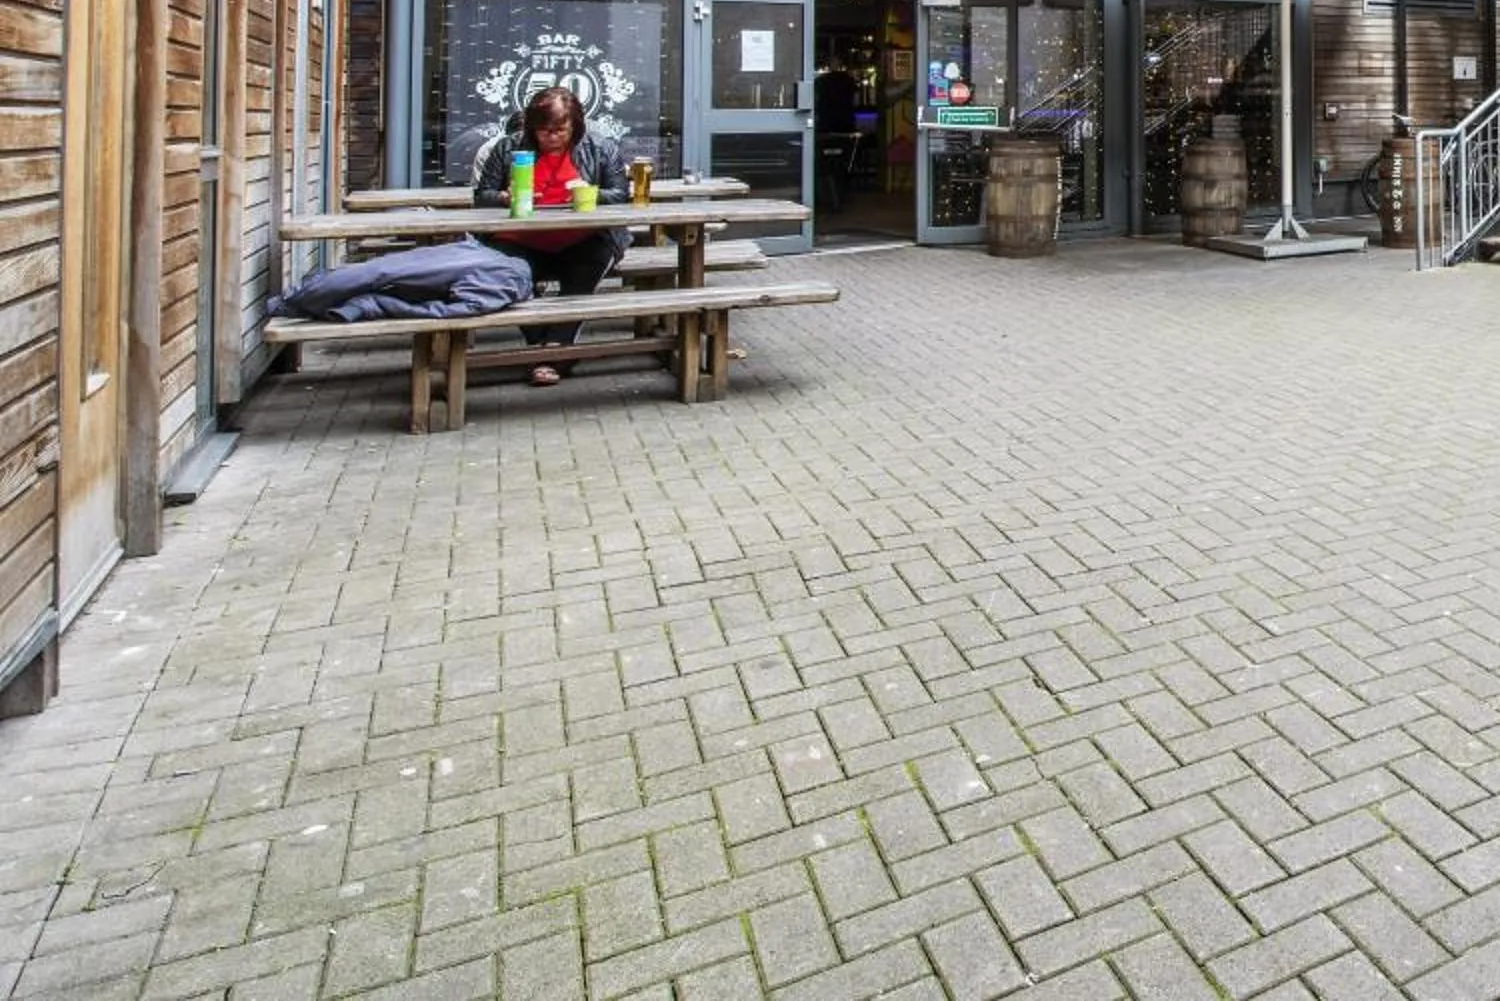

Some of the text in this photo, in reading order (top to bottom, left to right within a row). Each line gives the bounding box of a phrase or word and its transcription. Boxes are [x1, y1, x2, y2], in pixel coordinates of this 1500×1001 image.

[537, 33, 581, 45] BAR
[531, 54, 585, 70] FIFTY
[1392, 201, 1404, 232] GNN
